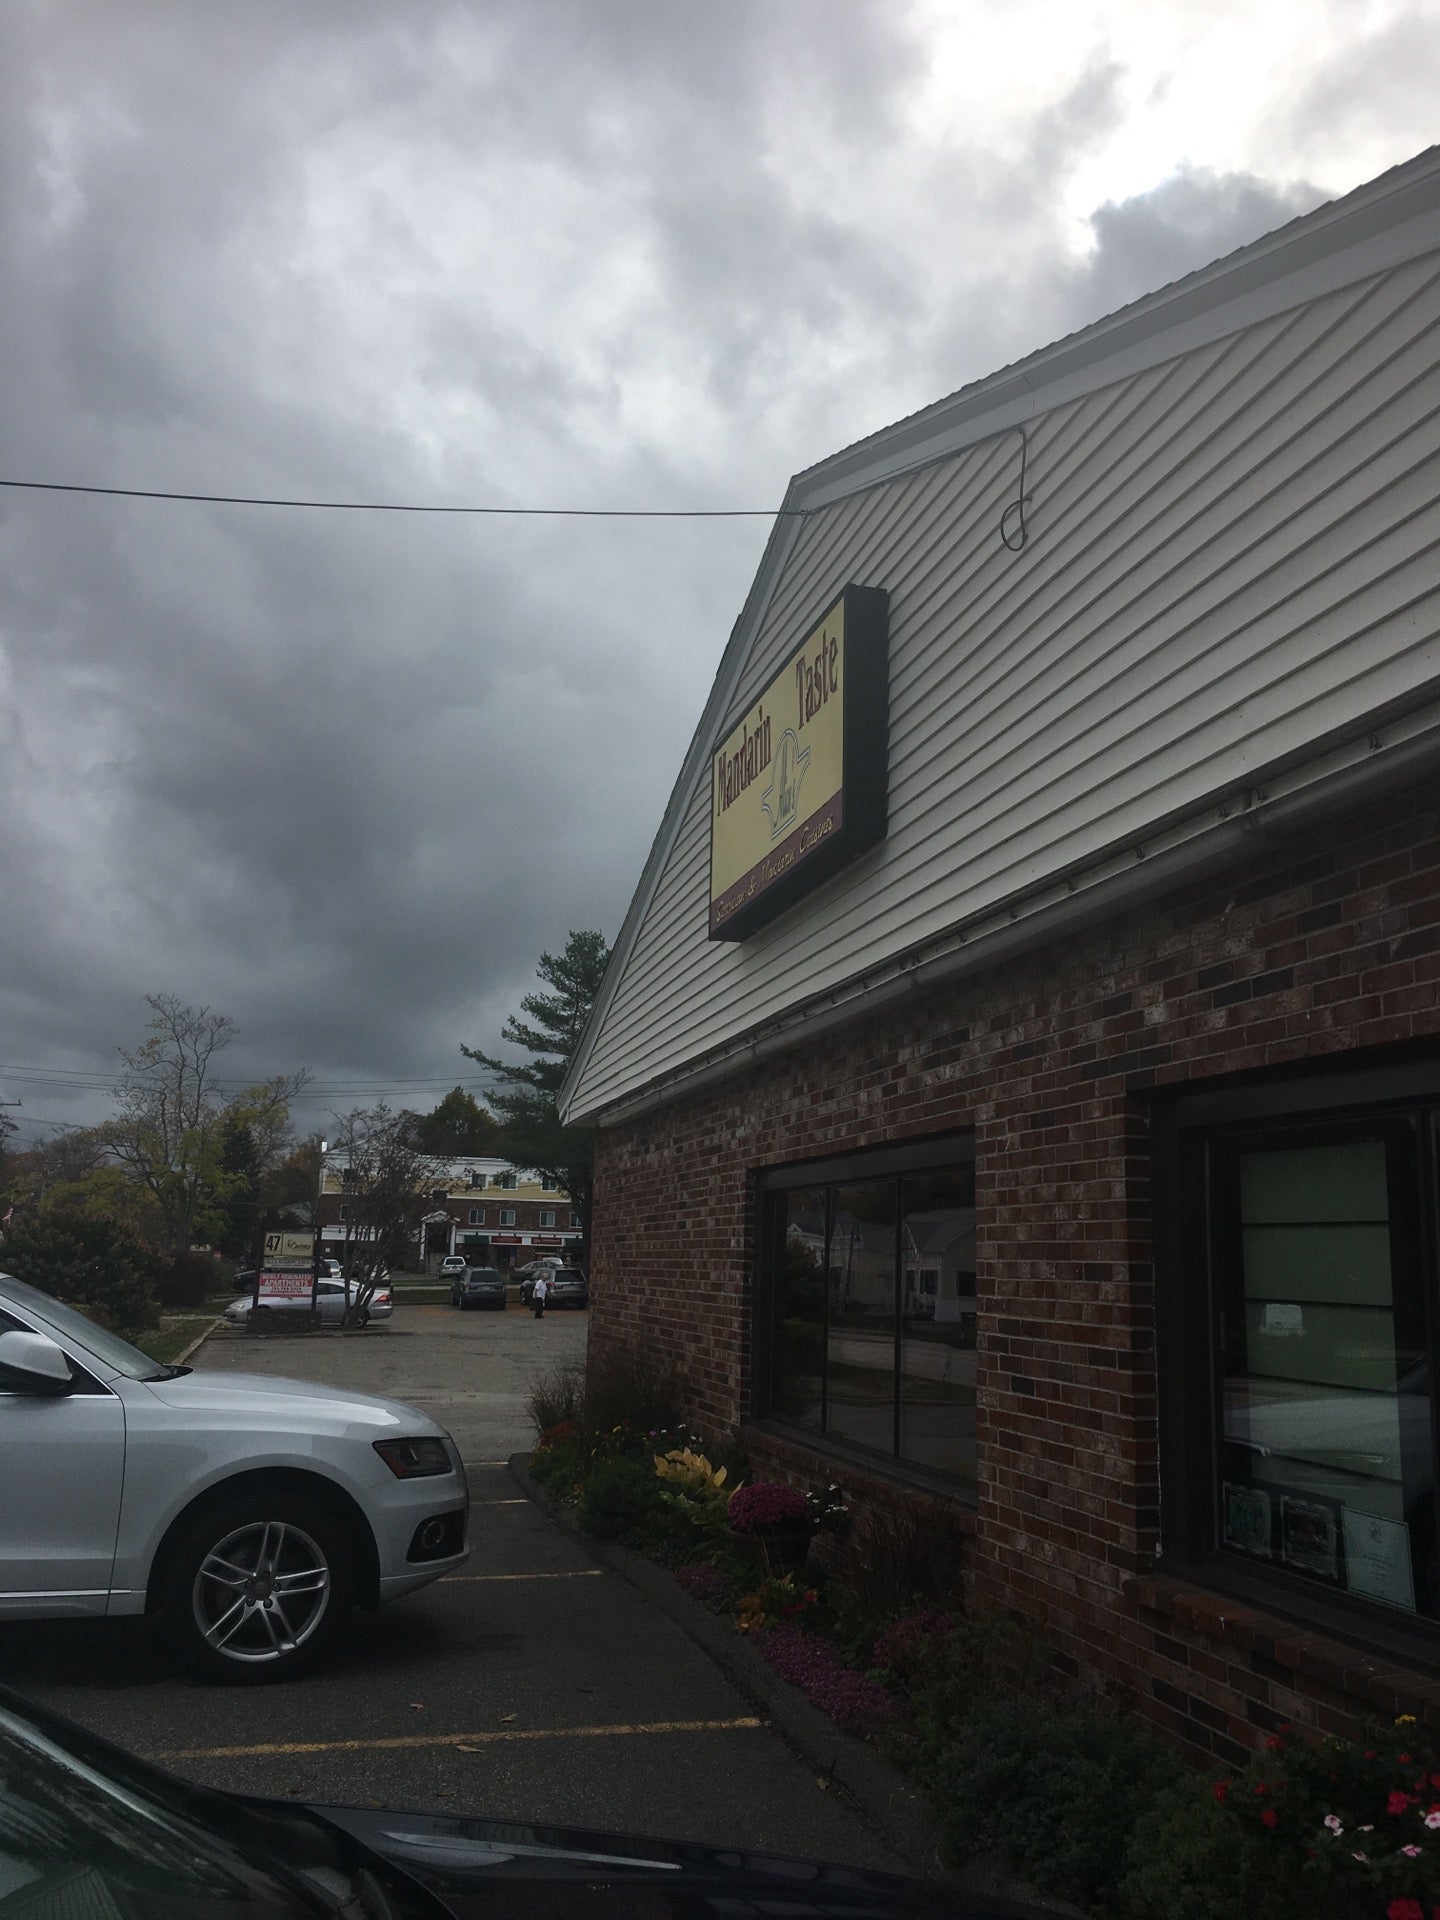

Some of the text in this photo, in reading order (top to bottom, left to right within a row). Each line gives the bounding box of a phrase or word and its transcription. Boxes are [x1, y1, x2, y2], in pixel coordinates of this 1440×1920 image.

[717, 629, 838, 817] Mandarin Taste
[748, 875, 757, 895] &
[266, 1235, 281, 1251] 47
